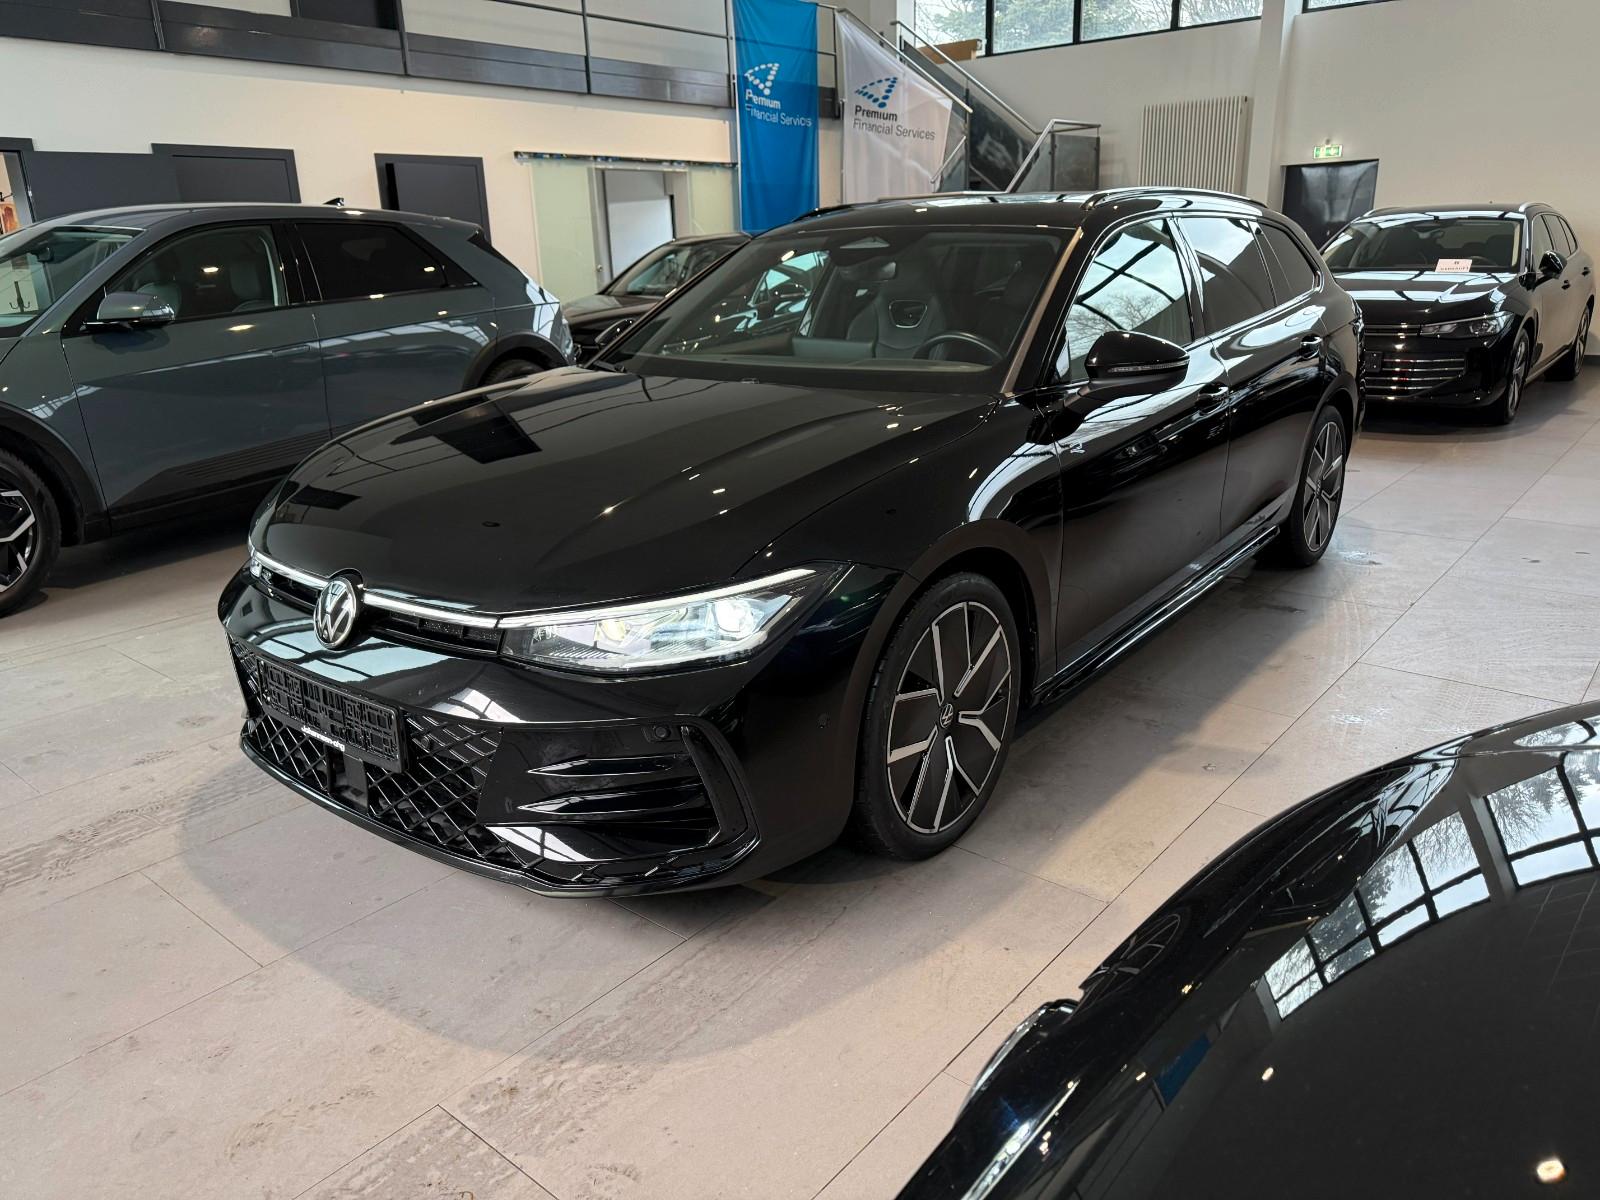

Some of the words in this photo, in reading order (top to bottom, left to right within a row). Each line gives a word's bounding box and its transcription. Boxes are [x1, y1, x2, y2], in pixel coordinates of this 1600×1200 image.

[854, 104, 898, 121] Premium
[852, 118, 894, 135] Financial
[895, 124, 936, 141] Services
